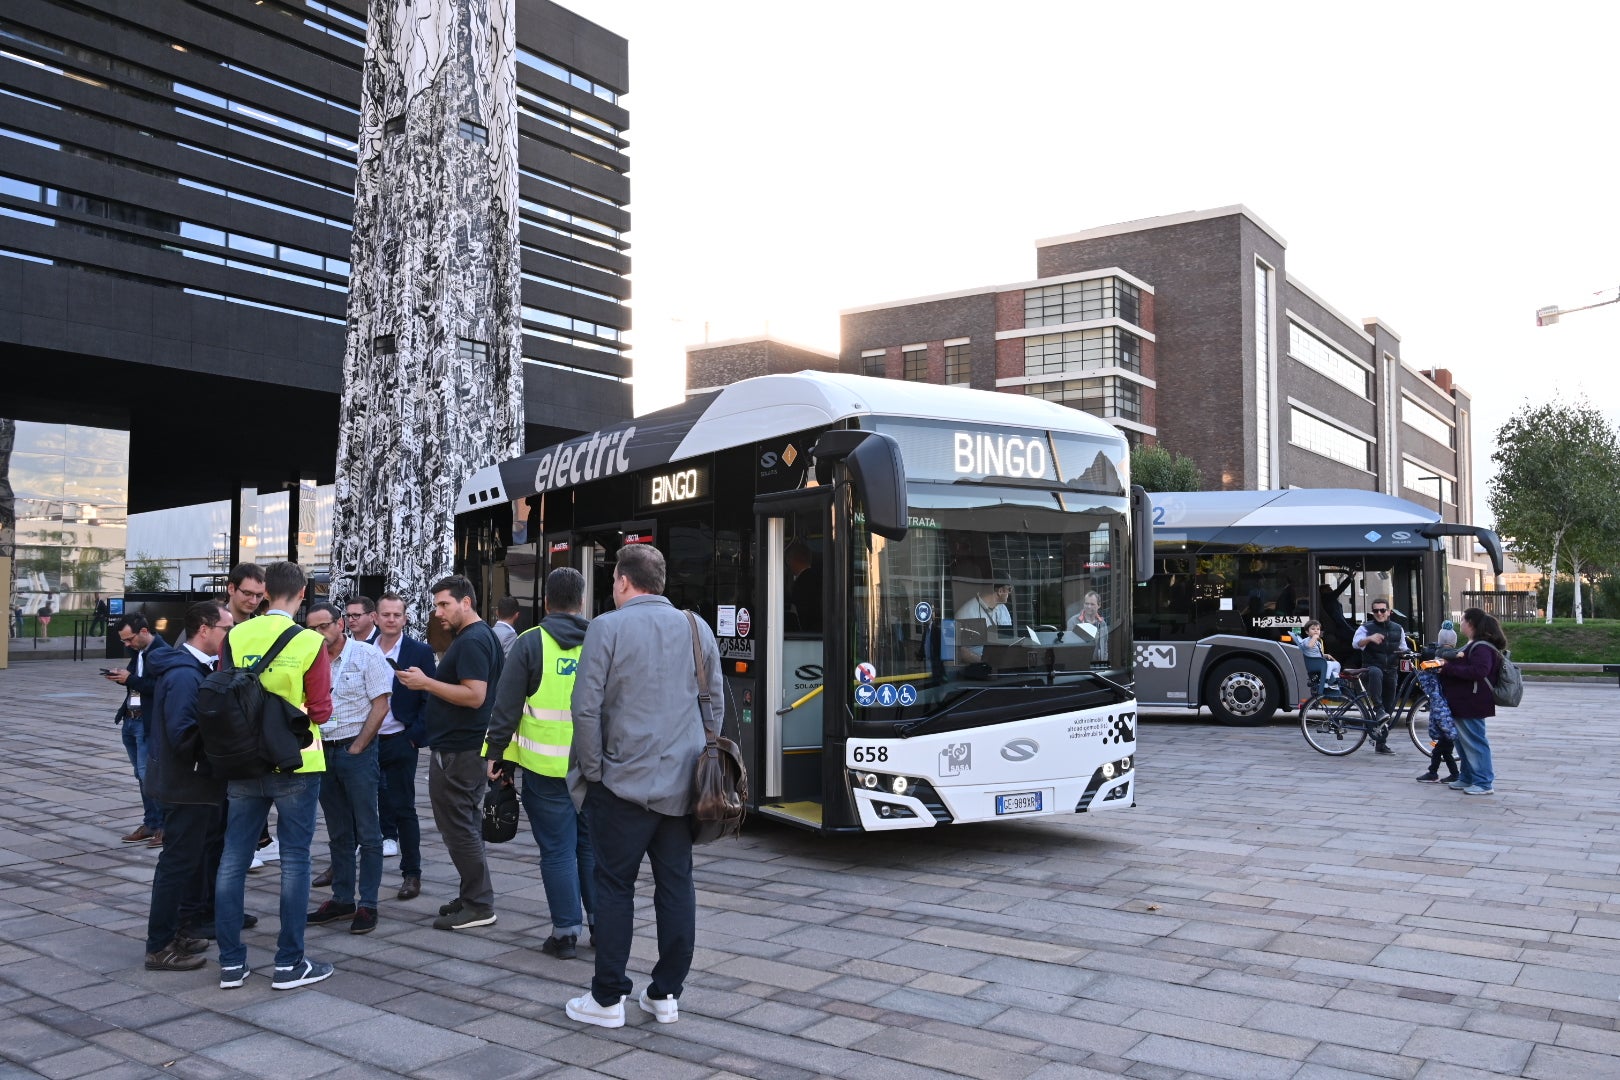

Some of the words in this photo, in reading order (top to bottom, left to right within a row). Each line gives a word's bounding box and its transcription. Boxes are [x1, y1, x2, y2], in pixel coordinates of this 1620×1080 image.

[535, 426, 637, 492] electric
[954, 432, 1046, 478] BINGO
[651, 469, 697, 505] BINGO
[1274, 615, 1303, 624] SASA
[728, 638, 752, 653] SASA
[853, 745, 889, 763] 658
[950, 764, 970, 773] SASA
